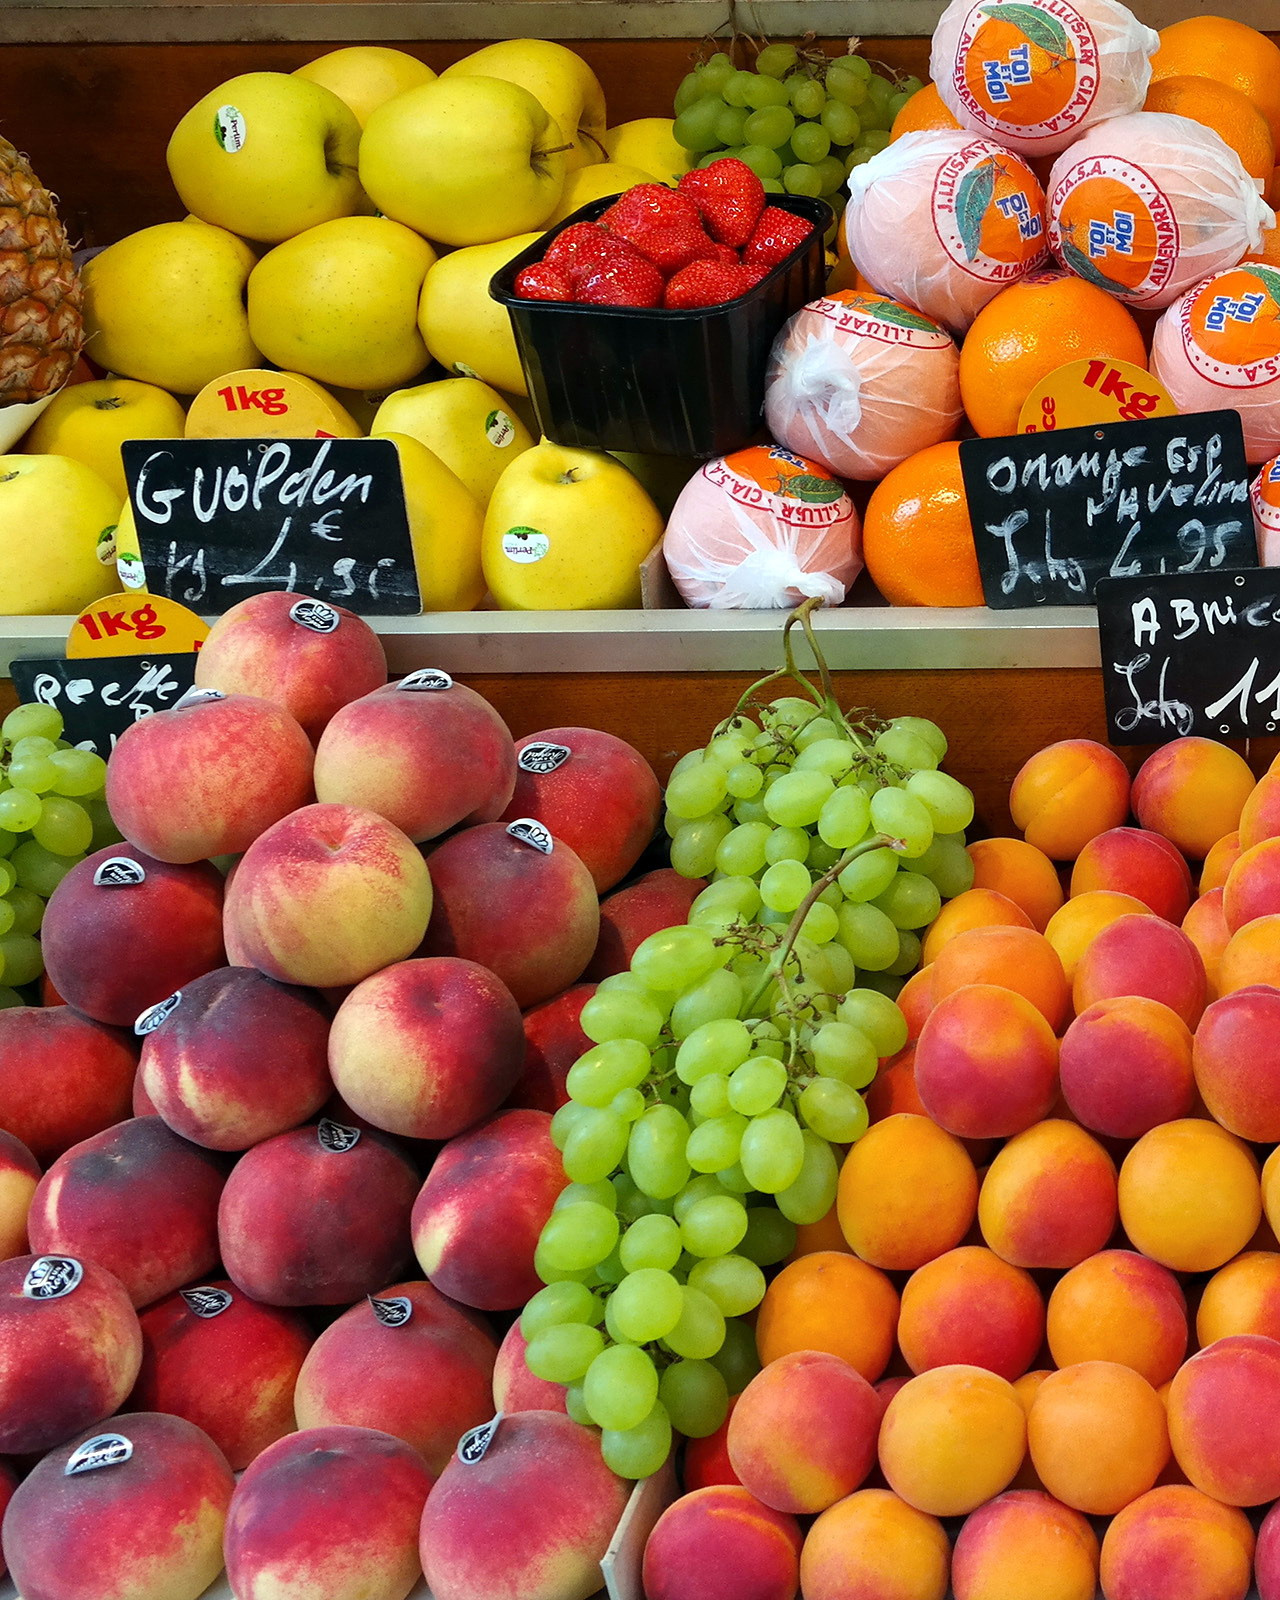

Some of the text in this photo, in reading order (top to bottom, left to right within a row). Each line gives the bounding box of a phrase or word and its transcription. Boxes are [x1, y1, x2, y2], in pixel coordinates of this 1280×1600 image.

[1000, 66, 1012, 82] ET
[1011, 44, 1031, 83] TOI
[985, 62, 1010, 102] MOI
[996, 193, 1028, 216] TOI
[1018, 210, 1030, 222] ET
[1020, 214, 1041, 238] MOI
[1090, 222, 1106, 258] TOI
[1105, 226, 1116, 245] ET
[1116, 212, 1133, 253] MOI
[1206, 296, 1230, 331] MOI
[1228, 302, 1240, 317] ET
[1236, 294, 1264, 322] TOI
[217, 386, 288, 416] 1kg
[1083, 360, 1160, 420] 1kg
[79, 604, 166, 641] 1kg
